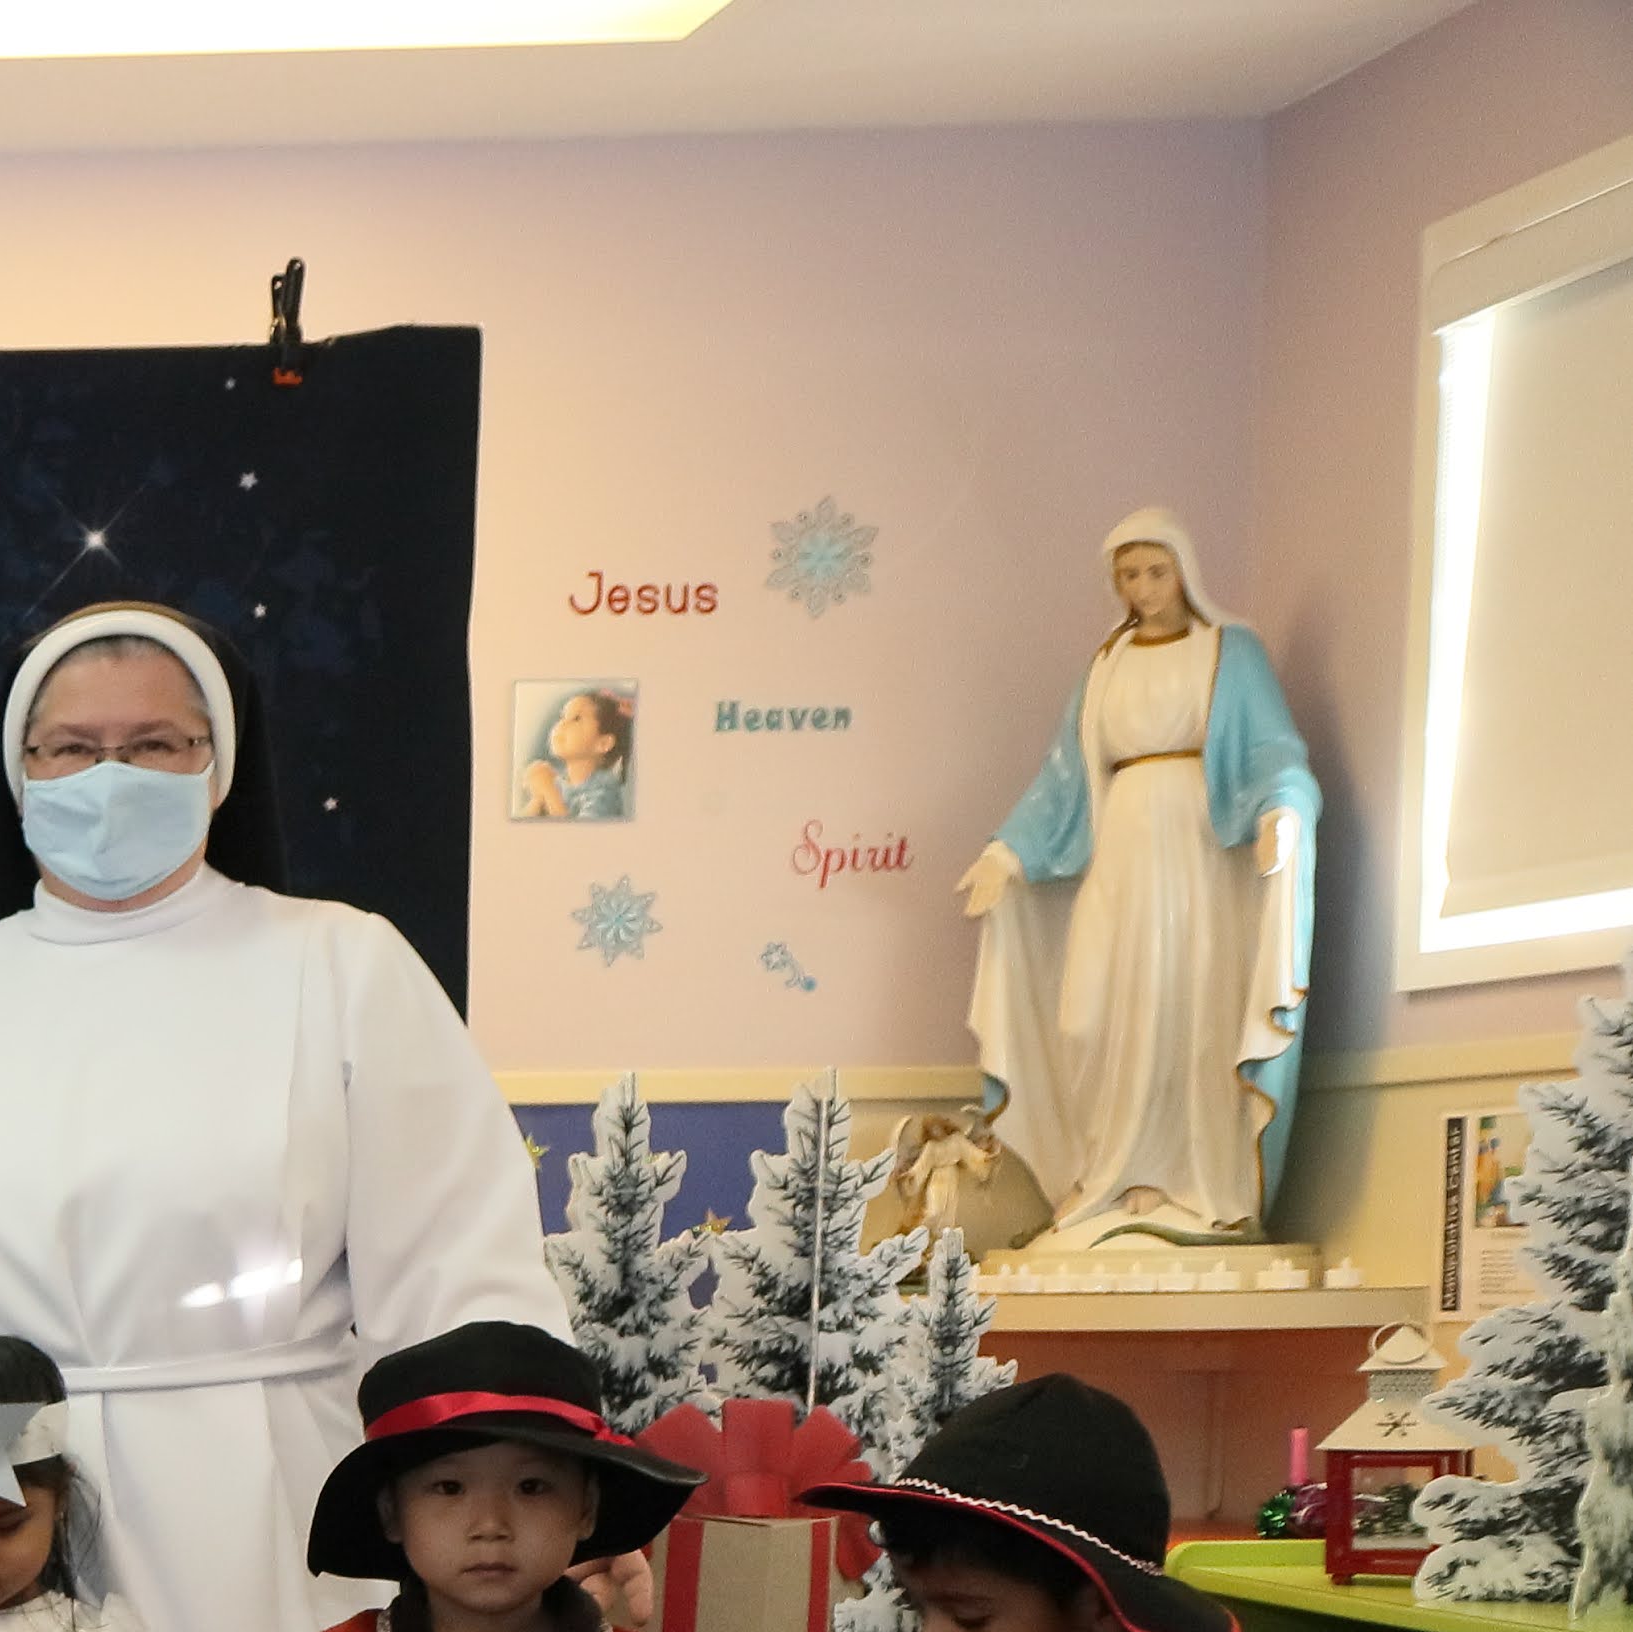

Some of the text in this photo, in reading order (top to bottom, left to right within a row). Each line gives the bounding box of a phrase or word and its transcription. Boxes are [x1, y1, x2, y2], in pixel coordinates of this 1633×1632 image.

[569, 571, 720, 614] Jesus
[714, 701, 853, 732] Heaven
[791, 819, 914, 889] Spirit
